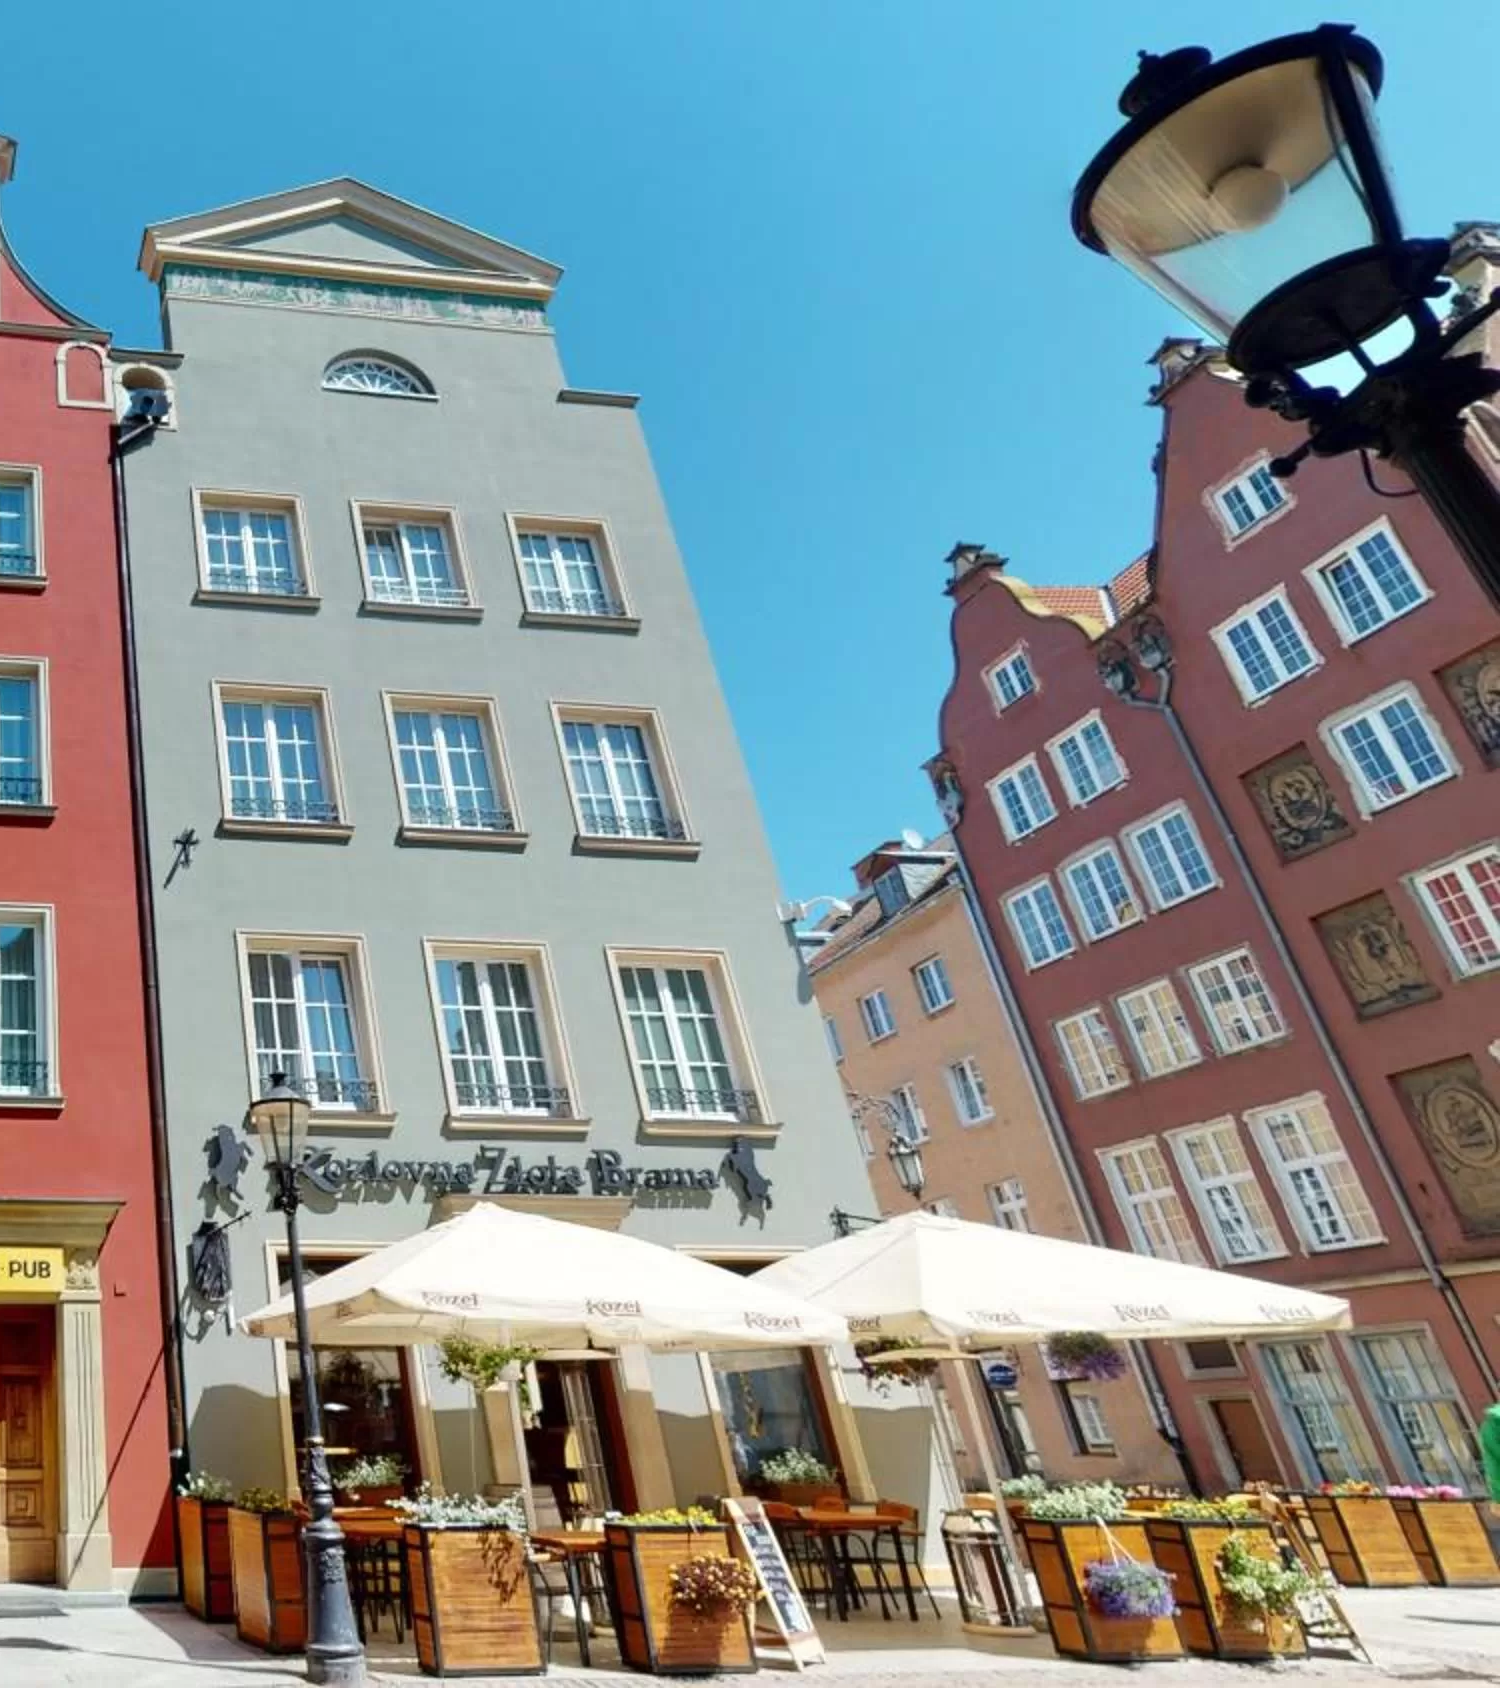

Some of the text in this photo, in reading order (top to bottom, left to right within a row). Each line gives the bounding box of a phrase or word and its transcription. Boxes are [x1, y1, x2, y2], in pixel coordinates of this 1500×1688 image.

[588, 1148, 721, 1193] Brama
[8, 1260, 51, 1279] PUB
[586, 1298, 642, 1317] Kozel
[743, 1311, 802, 1332] Kozel
